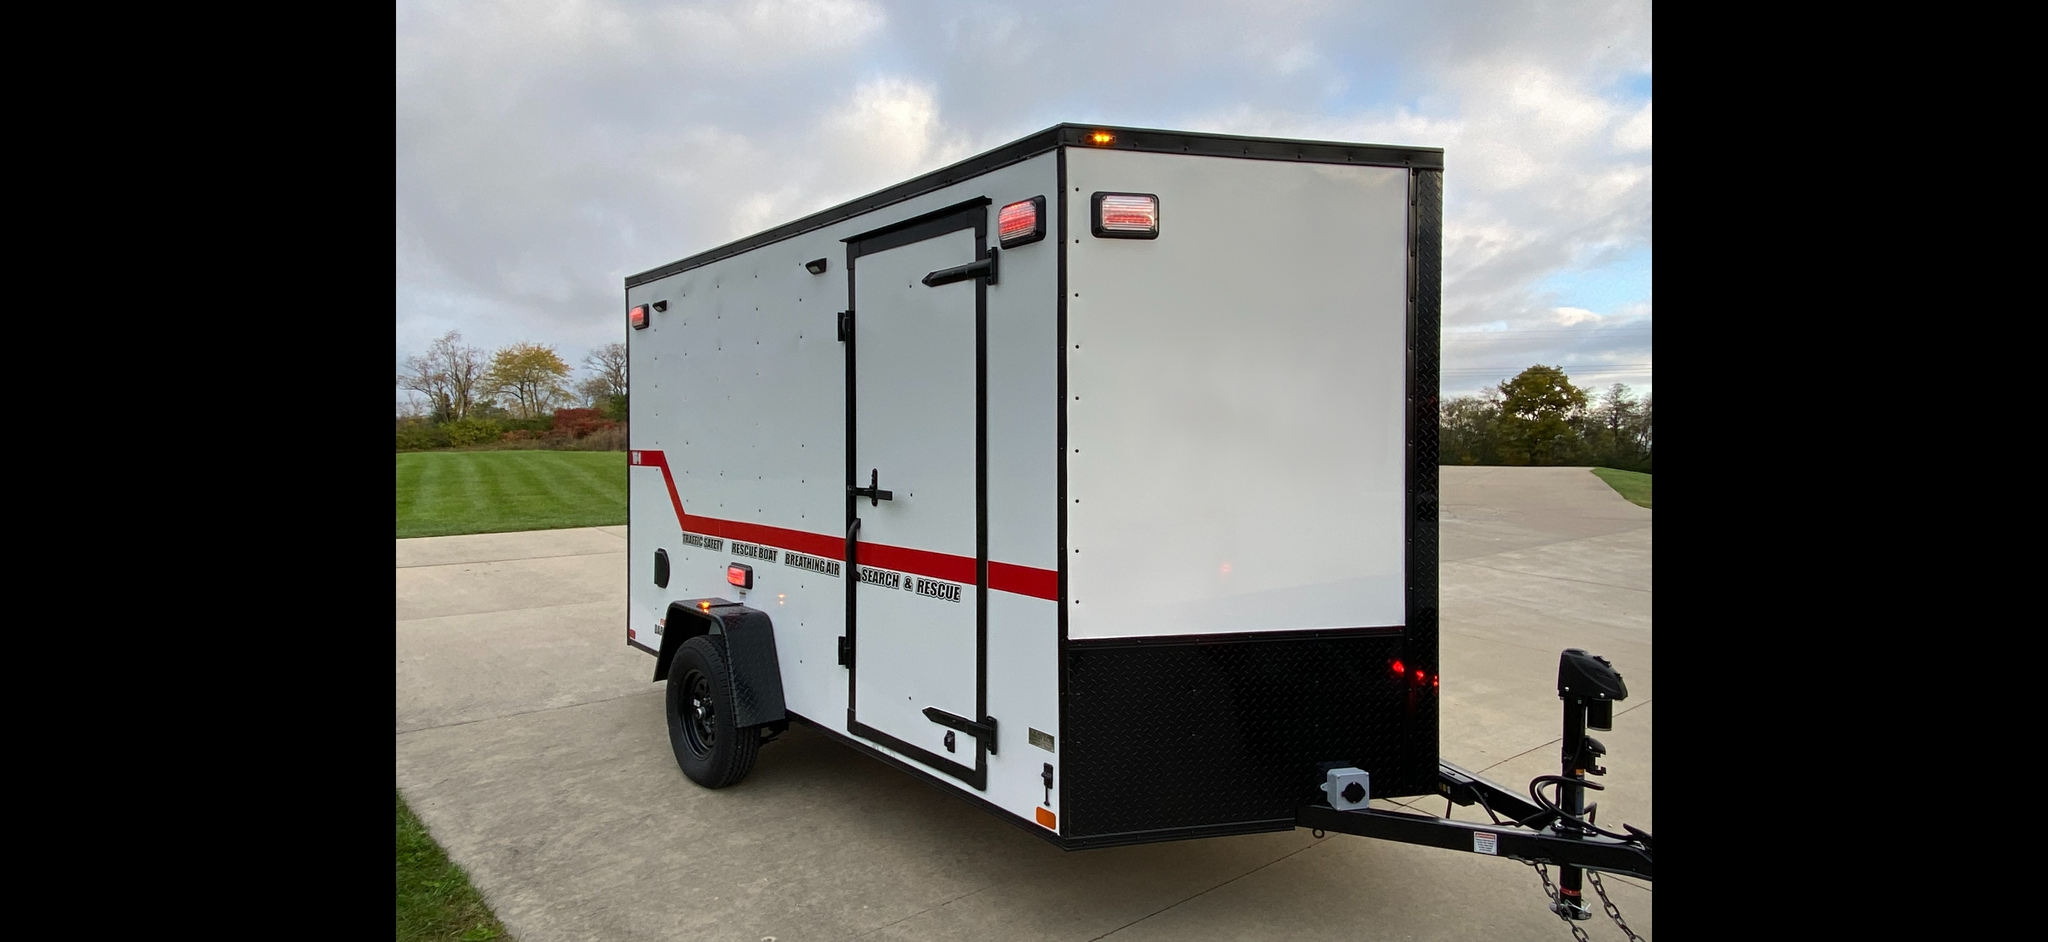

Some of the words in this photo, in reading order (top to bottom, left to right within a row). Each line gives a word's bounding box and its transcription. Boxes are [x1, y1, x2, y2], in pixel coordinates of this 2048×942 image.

[682, 533, 703, 547] TRAFFIC
[703, 537, 724, 551] SAFETY
[731, 541, 758, 557] RESCUE
[758, 546, 778, 562] BOAT
[785, 552, 826, 573] BREATHING
[826, 562, 840, 577] AIR
[861, 567, 900, 589] SEARCH
[904, 576, 913, 591] &
[916, 577, 962, 602] RESCUE
